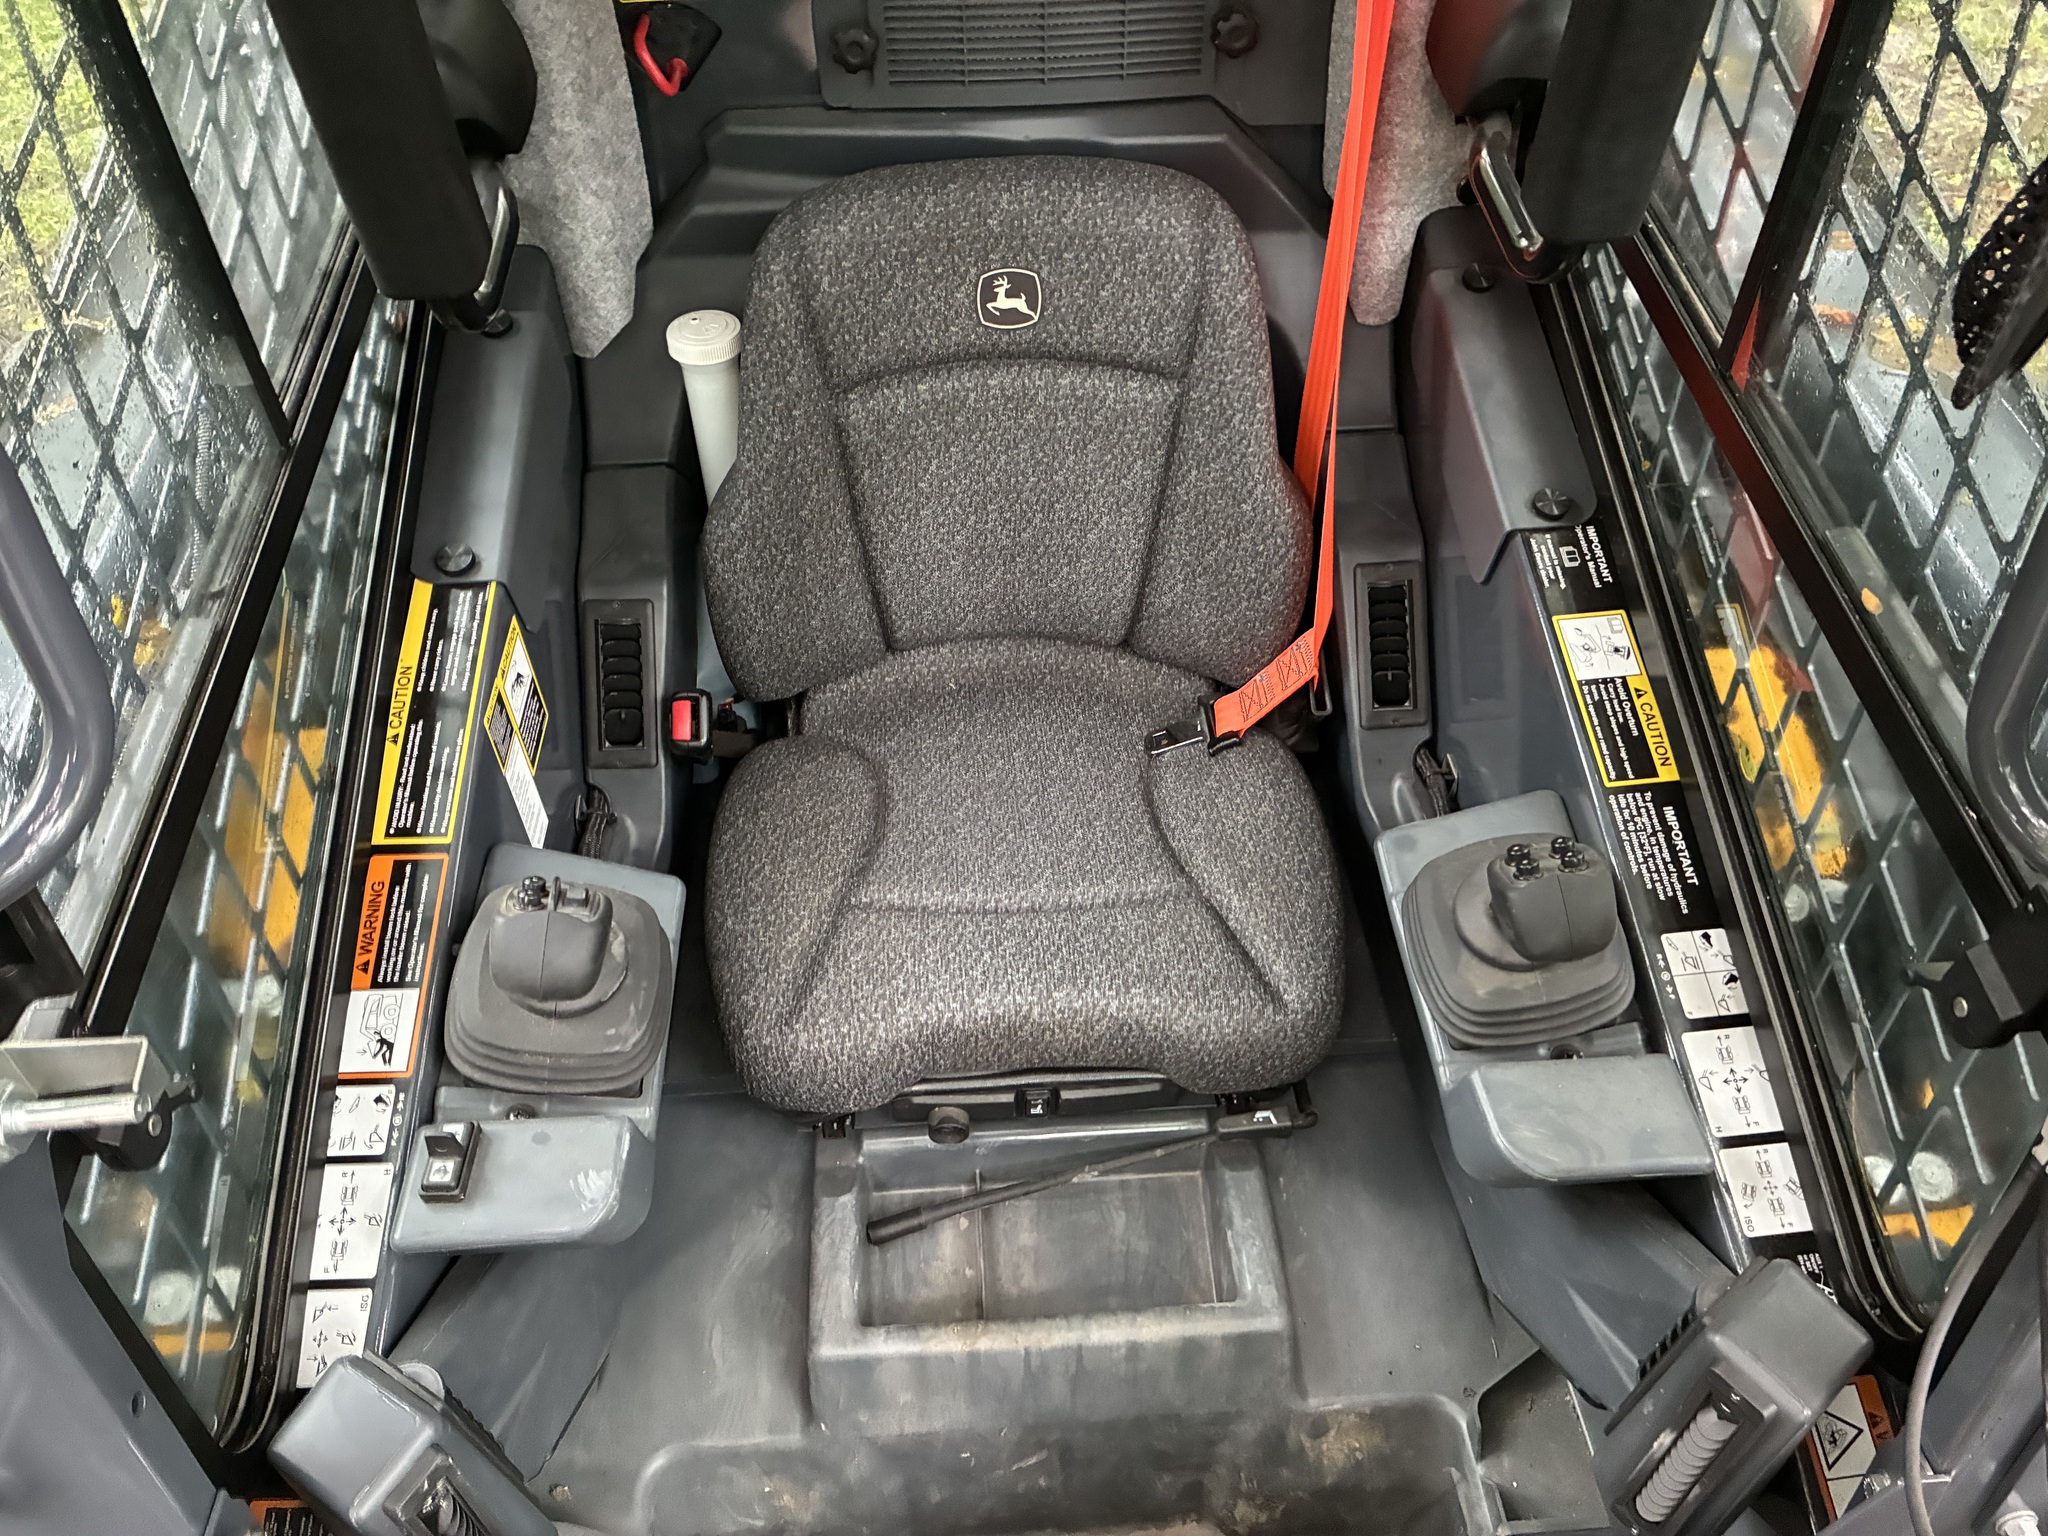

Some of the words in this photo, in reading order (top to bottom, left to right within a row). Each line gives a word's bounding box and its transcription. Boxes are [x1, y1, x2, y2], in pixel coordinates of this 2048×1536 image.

[1587, 526, 1612, 583] IMPORTANT
[1587, 561, 1602, 587] Manual
[421, 650, 429, 671] children
[418, 672, 426, 686] Keep
[462, 672, 470, 685] Keep
[1582, 685, 1589, 694] Do
[389, 666, 412, 728] CAUTION
[1585, 694, 1593, 703] not
[1607, 683, 1616, 698] Carry
[1613, 699, 1621, 711] load
[1614, 678, 1628, 700] Avoid
[1622, 701, 1638, 736] Overturn
[1588, 704, 1598, 725] operate
[1595, 726, 1603, 739] over
[1599, 684, 1609, 699] Avoid
[1604, 700, 1613, 716] steep
[1609, 716, 1619, 735] slopes
[1616, 736, 1624, 747] and
[1620, 747, 1628, 760] high
[1624, 761, 1634, 778] speed
[1640, 702, 1672, 766] CAUTION
[1599, 739, 1609, 754] rated
[398, 798, 408, 827] Operator's
[404, 776, 412, 797] Manual
[408, 757, 416, 776] before
[412, 731, 421, 757] operating
[421, 787, 429, 810] location
[427, 751, 436, 775] function
[395, 786, 403, 808] INJURY
[430, 811, 438, 827] Keep
[436, 771, 444, 793] devices
[1618, 794, 1626, 808] idle
[1626, 793, 1638, 815] below
[1644, 791, 1652, 801] To
[442, 811, 450, 827] Keep
[1609, 795, 1624, 831] operation
[1622, 809, 1631, 820] for
[1646, 802, 1662, 831] prevent
[1621, 831, 1629, 840] of
[1627, 822, 1635, 831] 10
[1630, 832, 1644, 863] minutes
[1635, 792, 1645, 806] and
[1640, 808, 1652, 835] engine,
[1652, 845, 1673, 897] temperatures
[1657, 832, 1671, 862] damage
[1663, 806, 1698, 885] IMPORTANT
[1624, 841, 1638, 875] controls.
[1647, 858, 1656, 871] run
[1667, 863, 1676, 872] of
[1640, 864, 1652, 889] before
[1652, 872, 1660, 880] at
[401, 877, 409, 903] machine
[1655, 882, 1665, 900] slow
[1670, 873, 1688, 914] hydraulics
[359, 881, 384, 956] WARNING
[394, 916, 402, 939] around
[414, 913, 422, 936] Manual
[385, 921, 393, 939] boom
[382, 939, 390, 959] install
[391, 947, 396, 956] on
[393, 939, 398, 947] or
[395, 951, 403, 971] loader
[399, 932, 407, 950] boom
[408, 936, 418, 969] Operator's
[377, 960, 386, 982] Always
[387, 956, 396, 982] working
[405, 969, 413, 982] See
[1744, 1216, 1755, 1232] ISO
